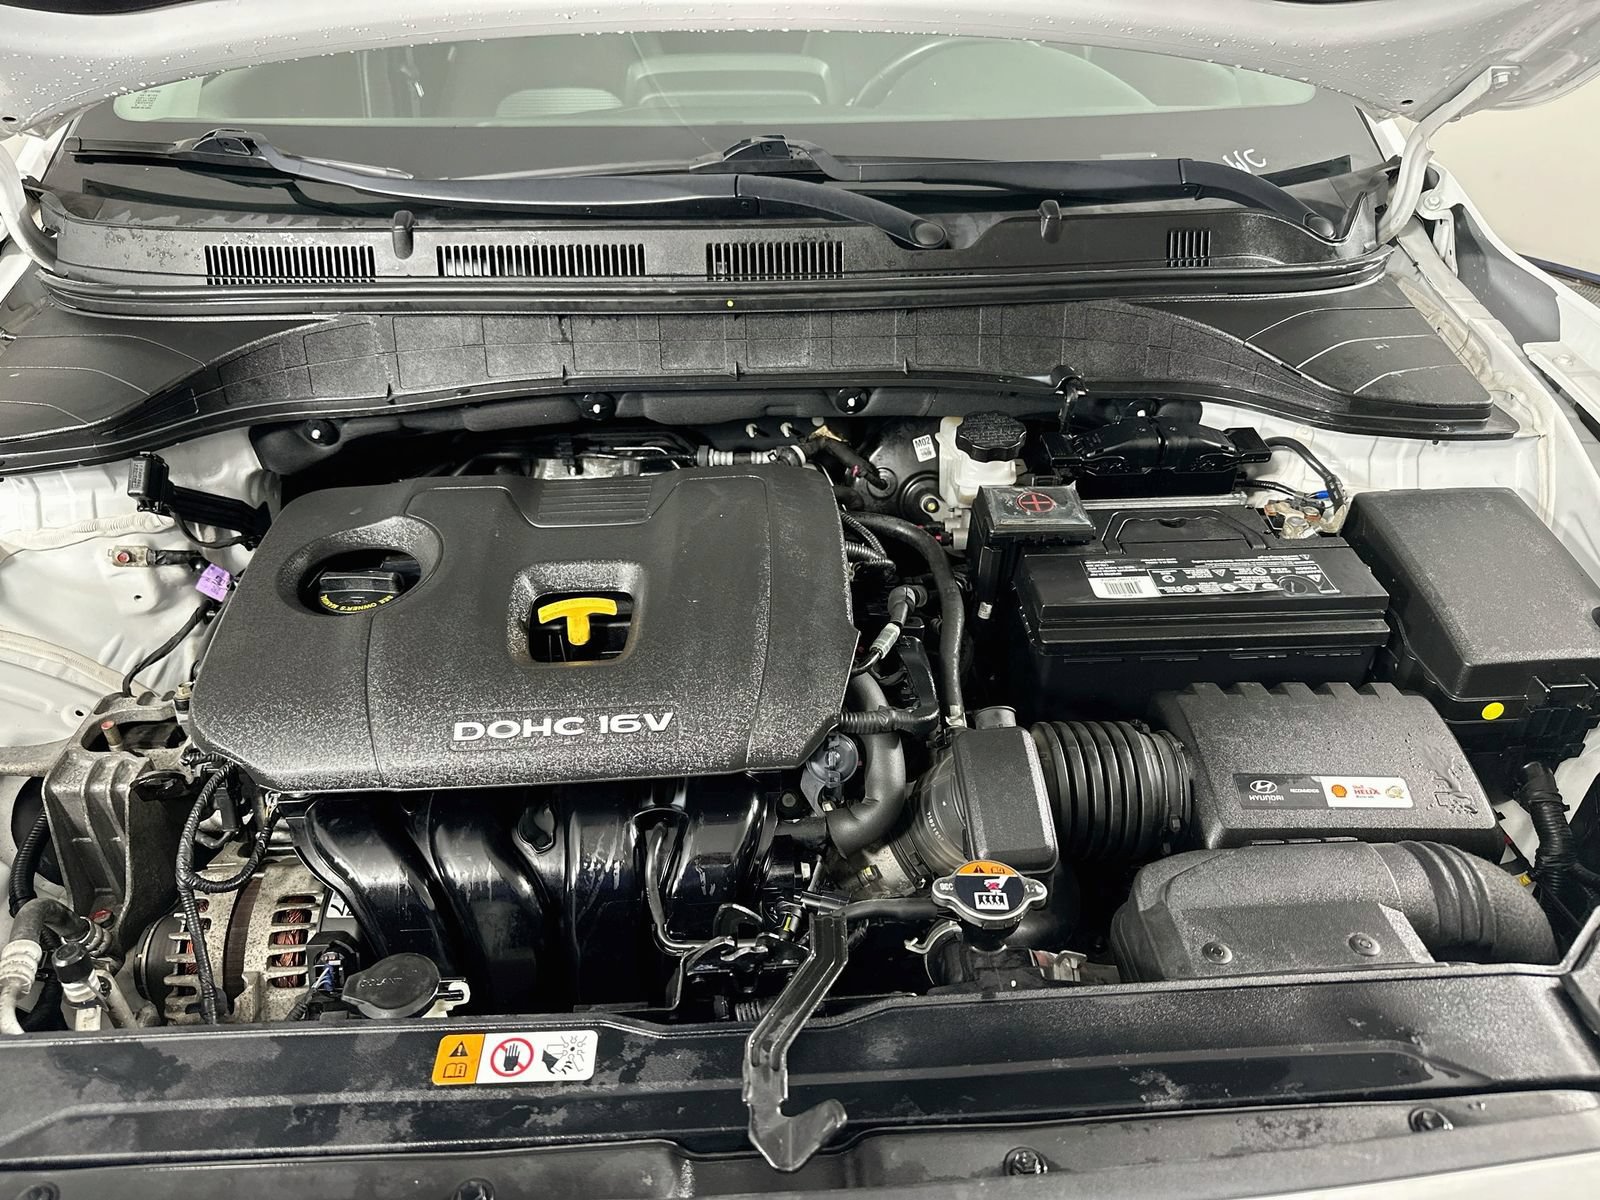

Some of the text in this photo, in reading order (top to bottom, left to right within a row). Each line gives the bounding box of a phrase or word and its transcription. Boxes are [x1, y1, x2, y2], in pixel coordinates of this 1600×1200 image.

[914, 436, 931, 448] M02
[453, 712, 674, 741] DOHC 16V
